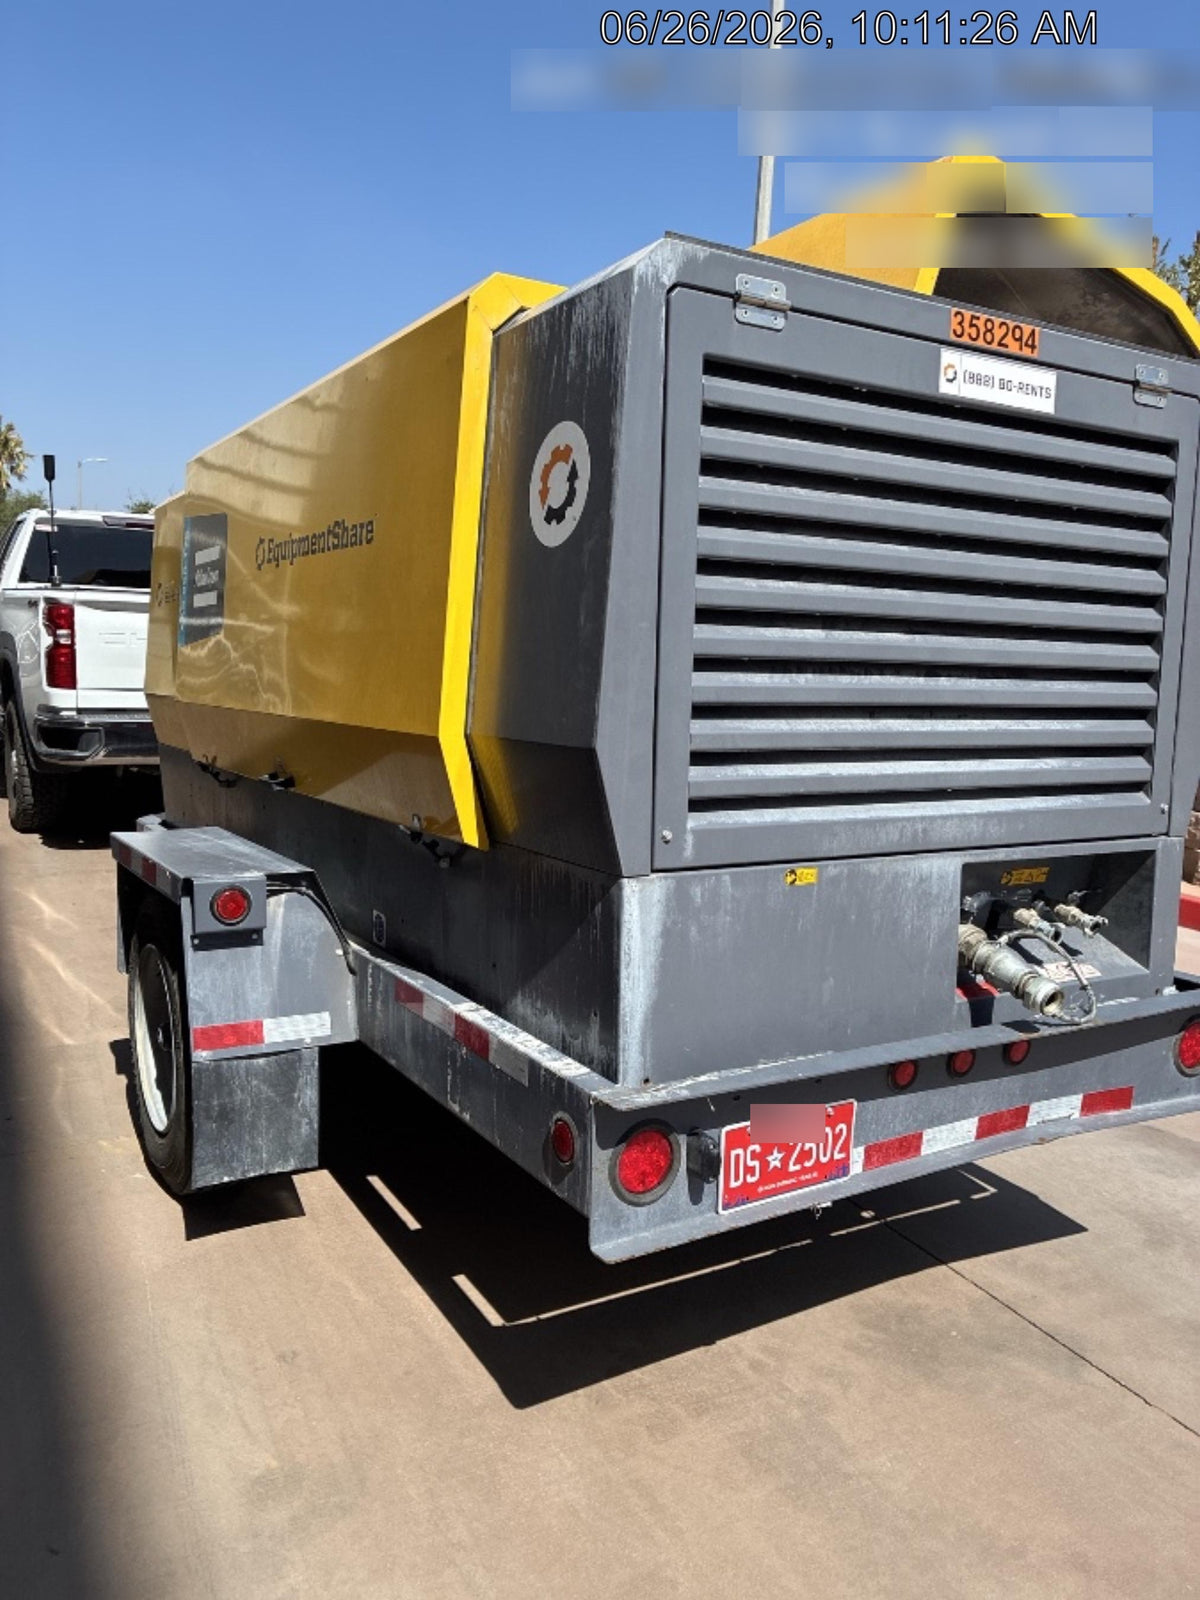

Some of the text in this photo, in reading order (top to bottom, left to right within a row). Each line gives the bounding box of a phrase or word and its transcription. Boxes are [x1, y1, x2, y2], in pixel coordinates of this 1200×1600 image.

[952, 310, 1037, 354] 358294
[266, 519, 374, 568] EquipmentShare
[729, 1144, 761, 1188] DS
